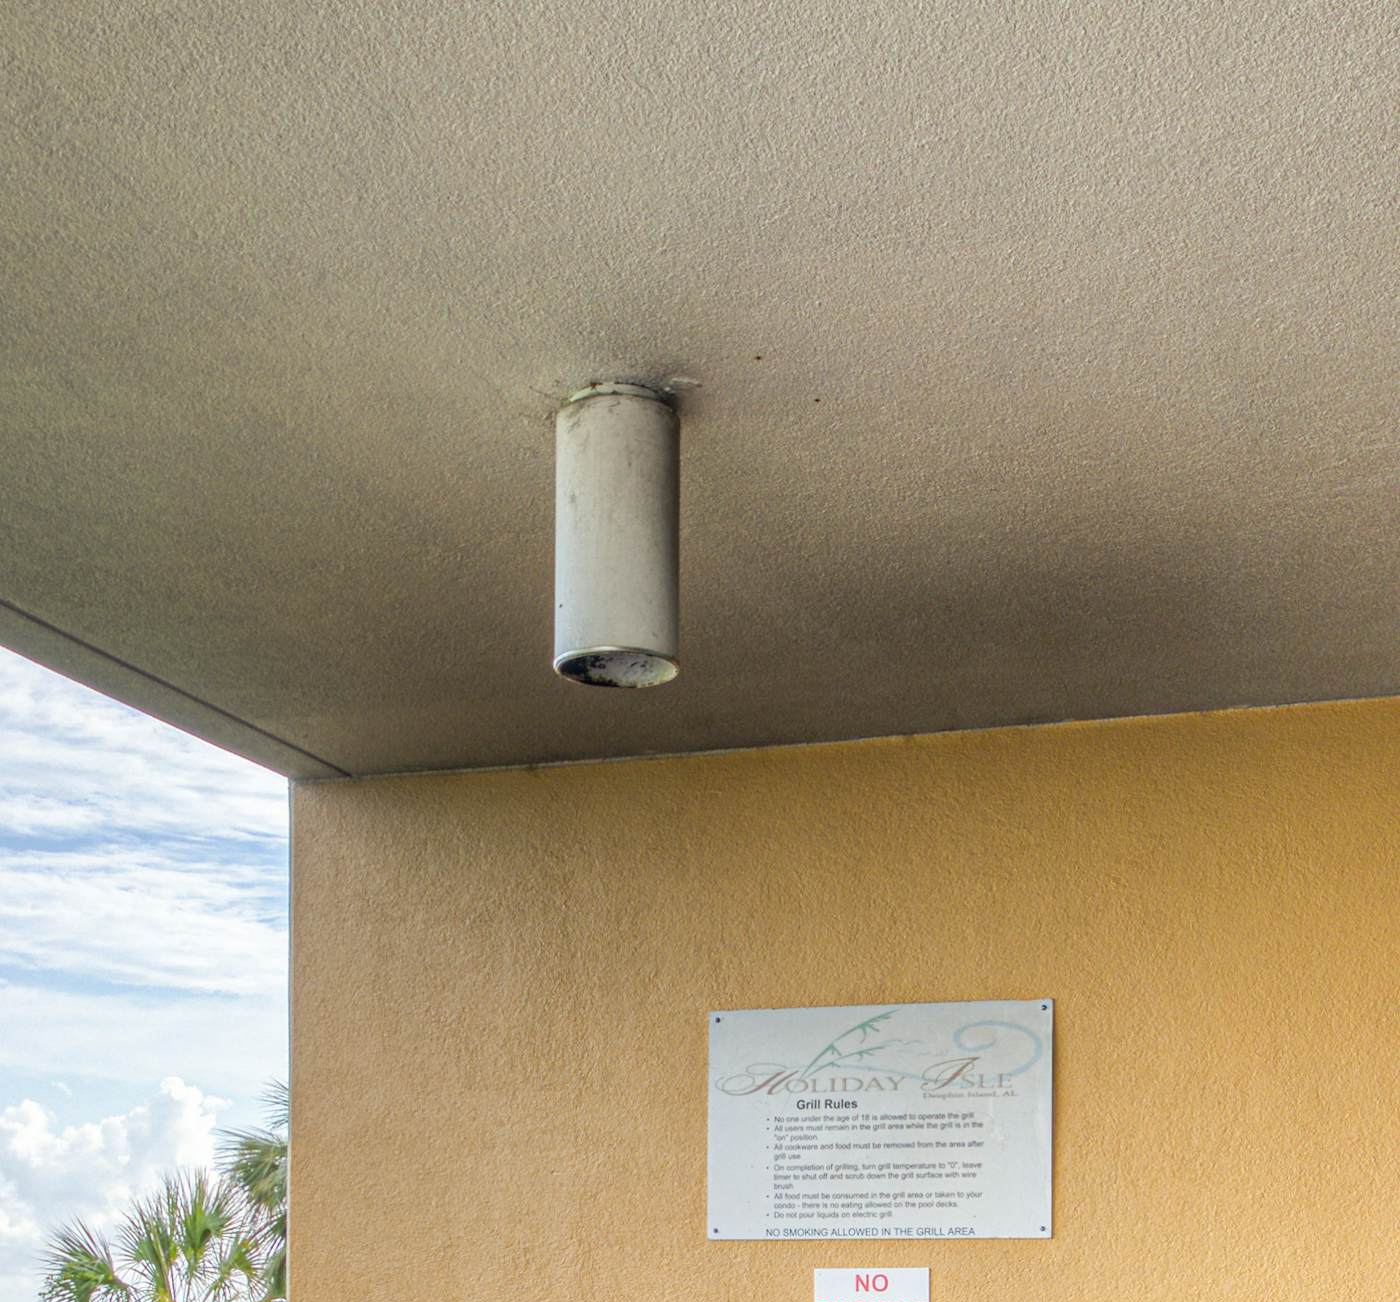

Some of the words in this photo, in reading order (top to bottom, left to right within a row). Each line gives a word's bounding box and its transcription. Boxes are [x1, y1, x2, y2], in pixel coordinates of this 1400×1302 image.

[716, 1063, 905, 1096] HOLIDAY
[920, 1057, 1013, 1091] ISLE
[796, 1099, 821, 1110] Grill
[824, 1098, 858, 1110] Rules
[918, 1113, 946, 1121] operate
[873, 1123, 886, 1131] grill
[940, 1122, 953, 1130] grill
[774, 1153, 786, 1161] grill
[766, 1228, 780, 1236] NO
[783, 1228, 828, 1236] SMOKING
[831, 1228, 879, 1236] ALLOWED
[881, 1228, 891, 1236] IN
[895, 1228, 913, 1236] THE
[916, 1227, 945, 1236] GRILL
[948, 1227, 976, 1236] AREA
[855, 1274, 889, 1292] NO
